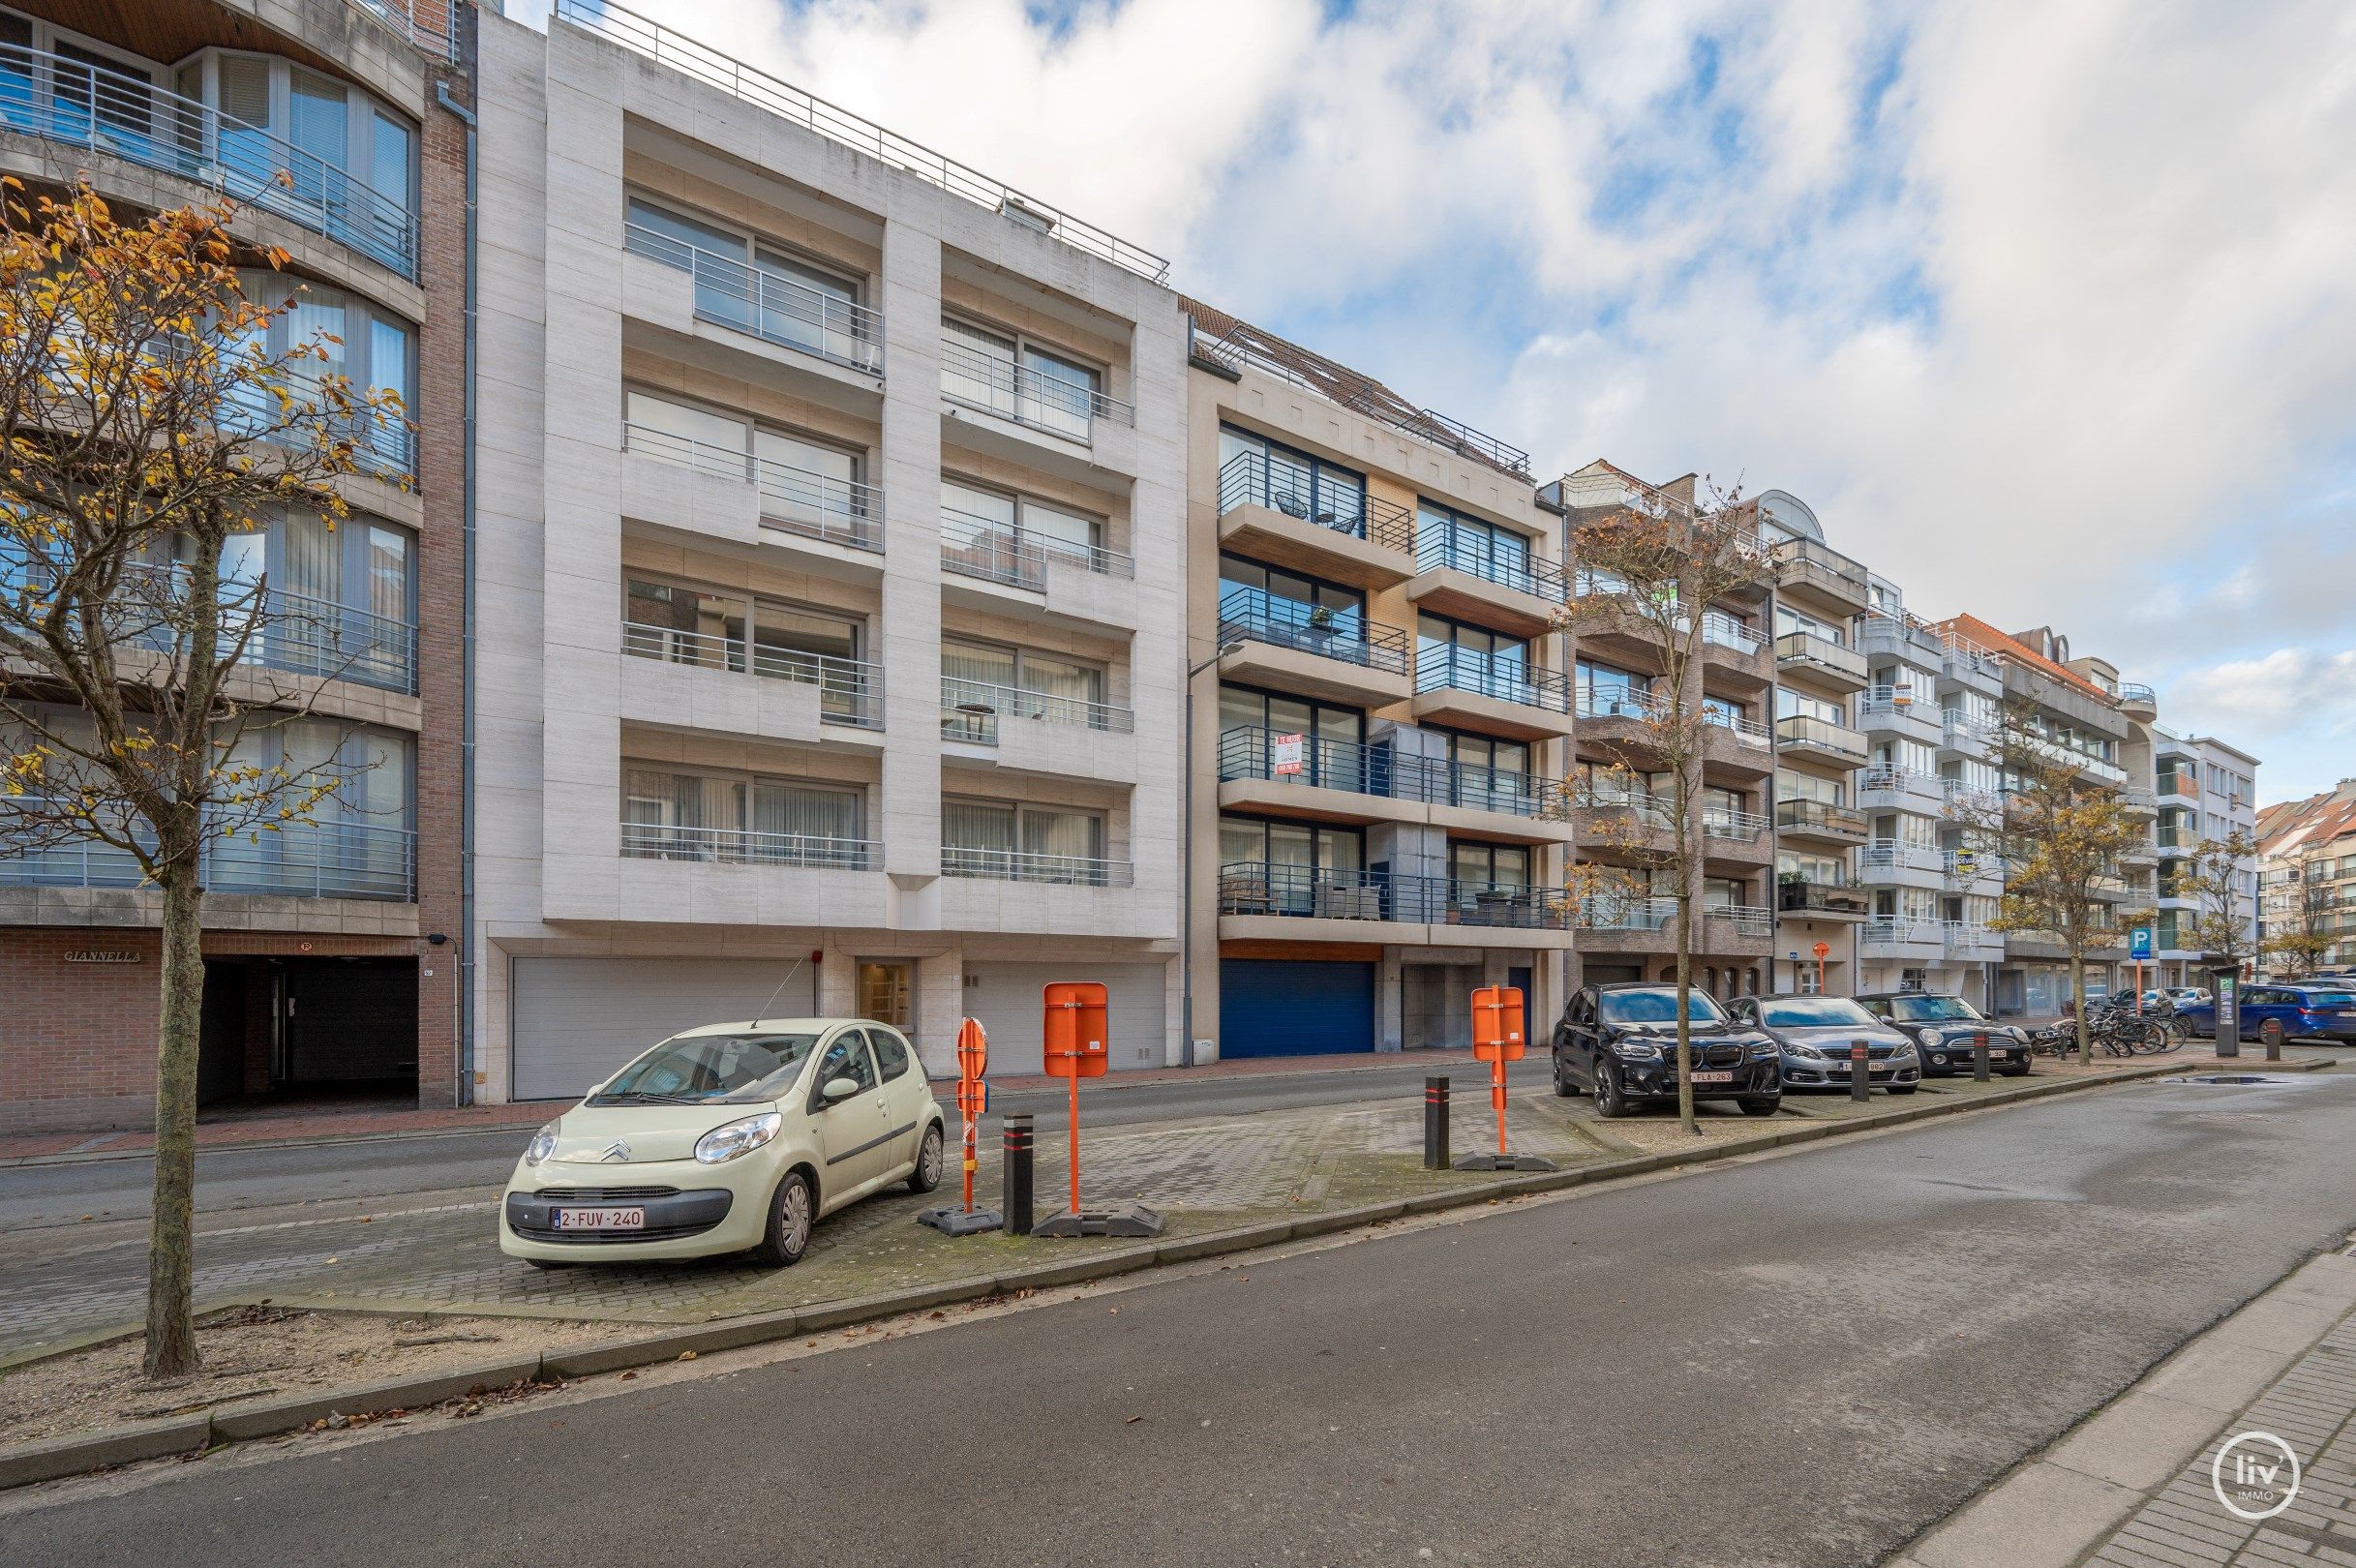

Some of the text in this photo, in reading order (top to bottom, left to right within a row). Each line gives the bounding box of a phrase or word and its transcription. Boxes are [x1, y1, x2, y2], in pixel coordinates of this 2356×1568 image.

[2134, 931, 2148, 949] P
[64, 951, 140, 963] GIANNELLA
[561, 1212, 641, 1226] 2-FUV-240
